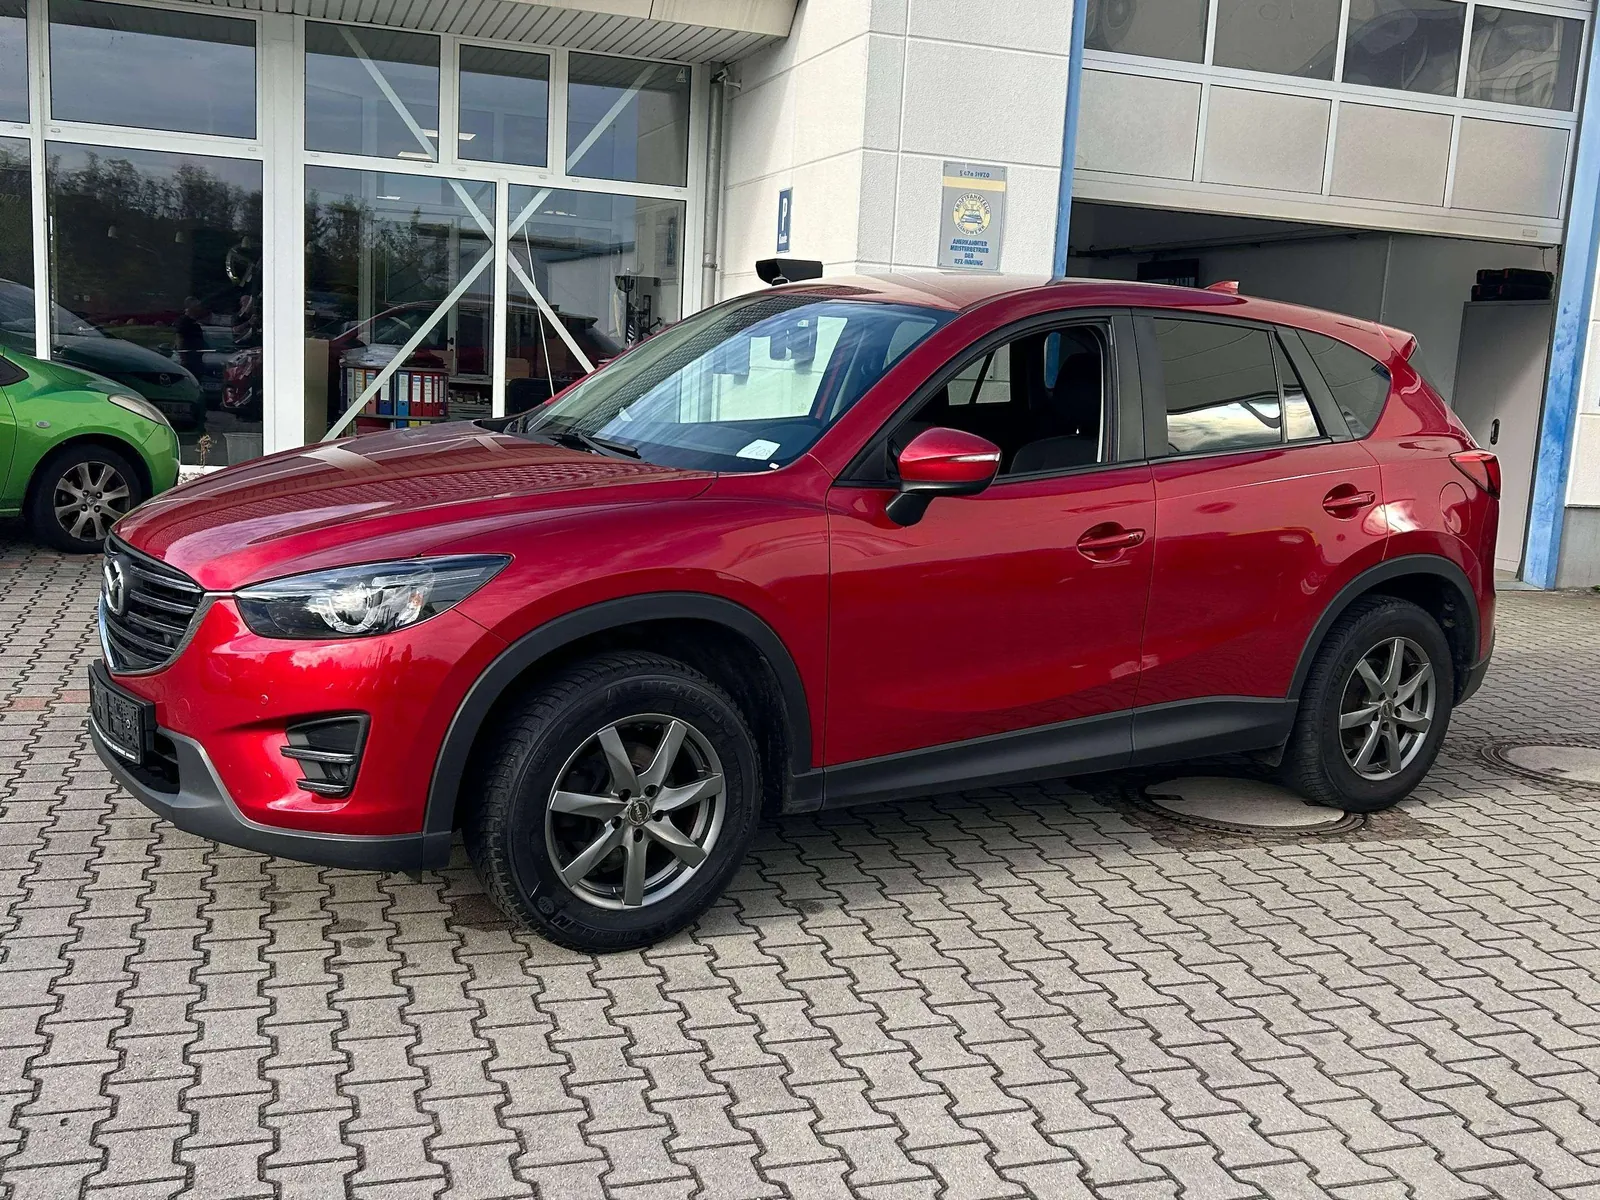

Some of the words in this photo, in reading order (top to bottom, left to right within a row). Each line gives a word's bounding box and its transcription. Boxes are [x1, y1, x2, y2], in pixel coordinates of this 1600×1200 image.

[782, 197, 788, 231] P
[952, 239, 988, 247] ANERKANNTER
[950, 245, 989, 254] MEISTERBETRIEB
